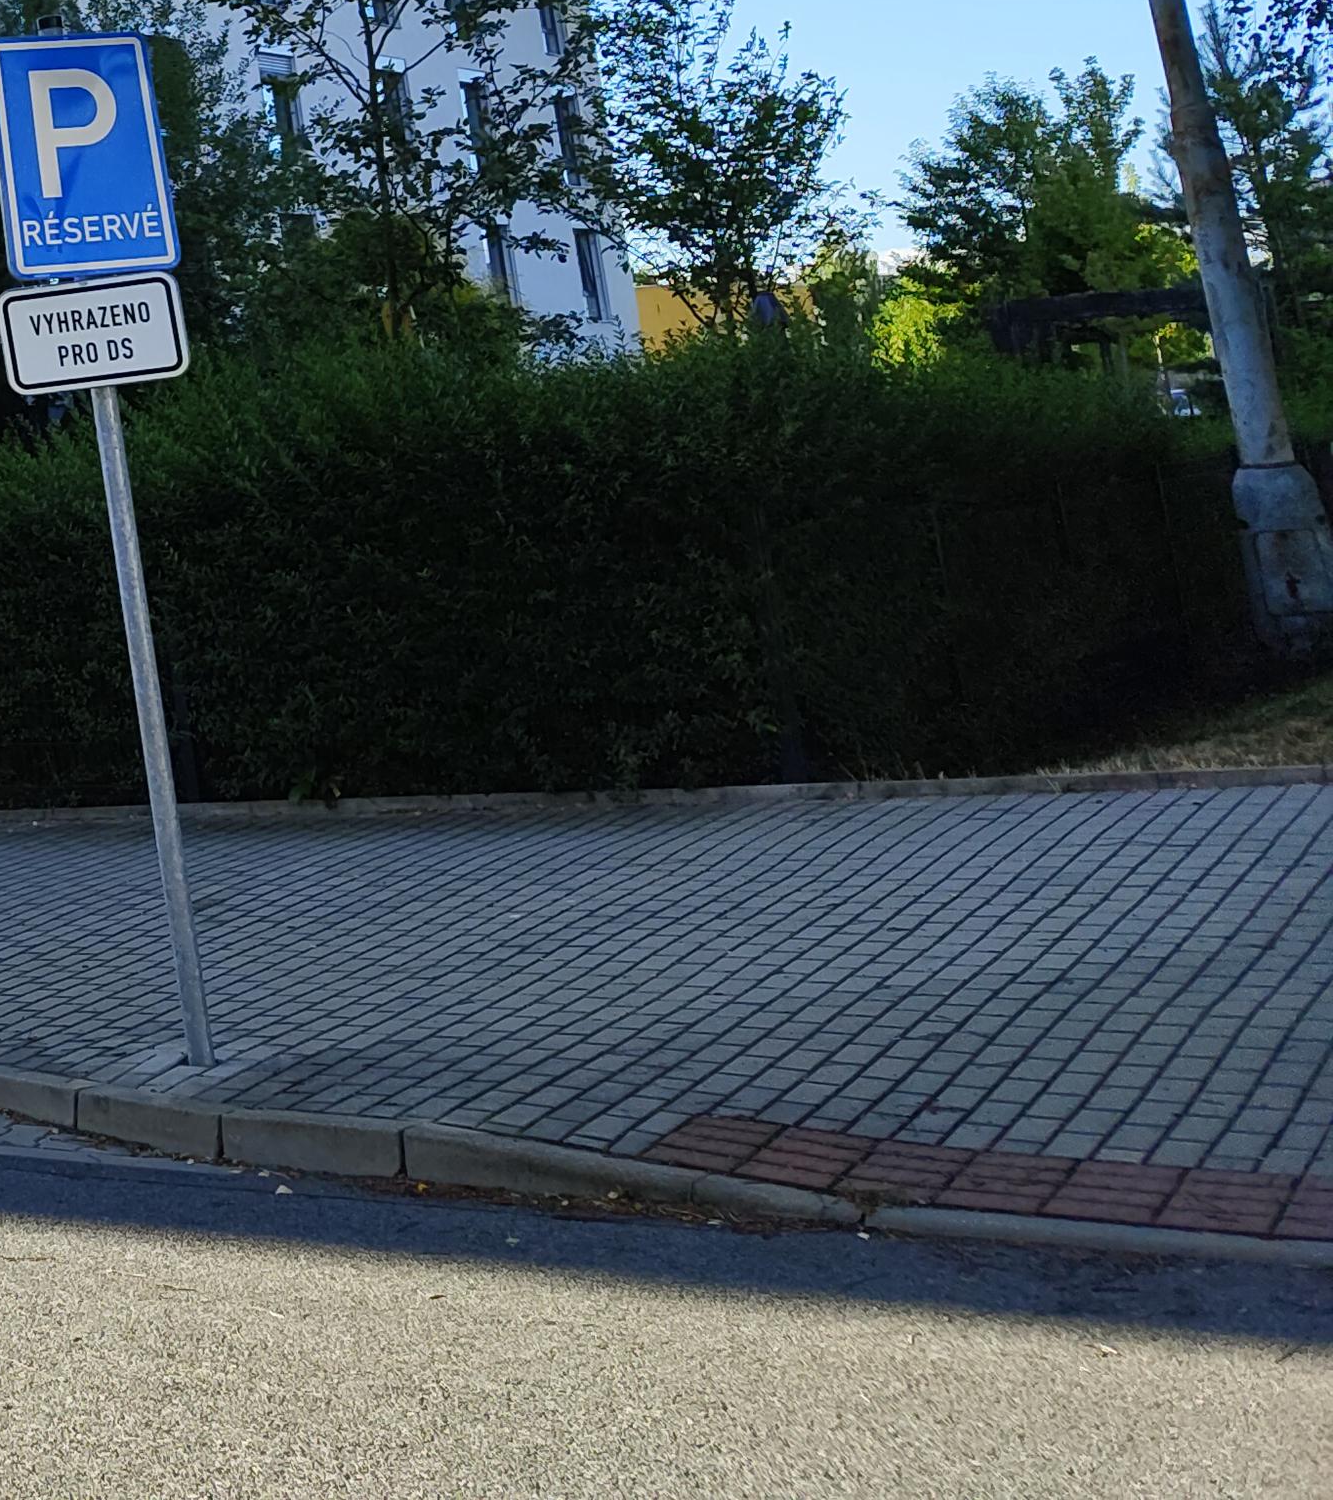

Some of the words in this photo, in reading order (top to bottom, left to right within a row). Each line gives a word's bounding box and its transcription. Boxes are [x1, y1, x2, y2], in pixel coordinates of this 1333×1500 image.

[27, 67, 117, 199] P
[22, 203, 162, 247] RÉSERVÉ
[29, 301, 151, 336] VYHRAZENO
[57, 342, 99, 367] PRO
[106, 337, 134, 361] DS
